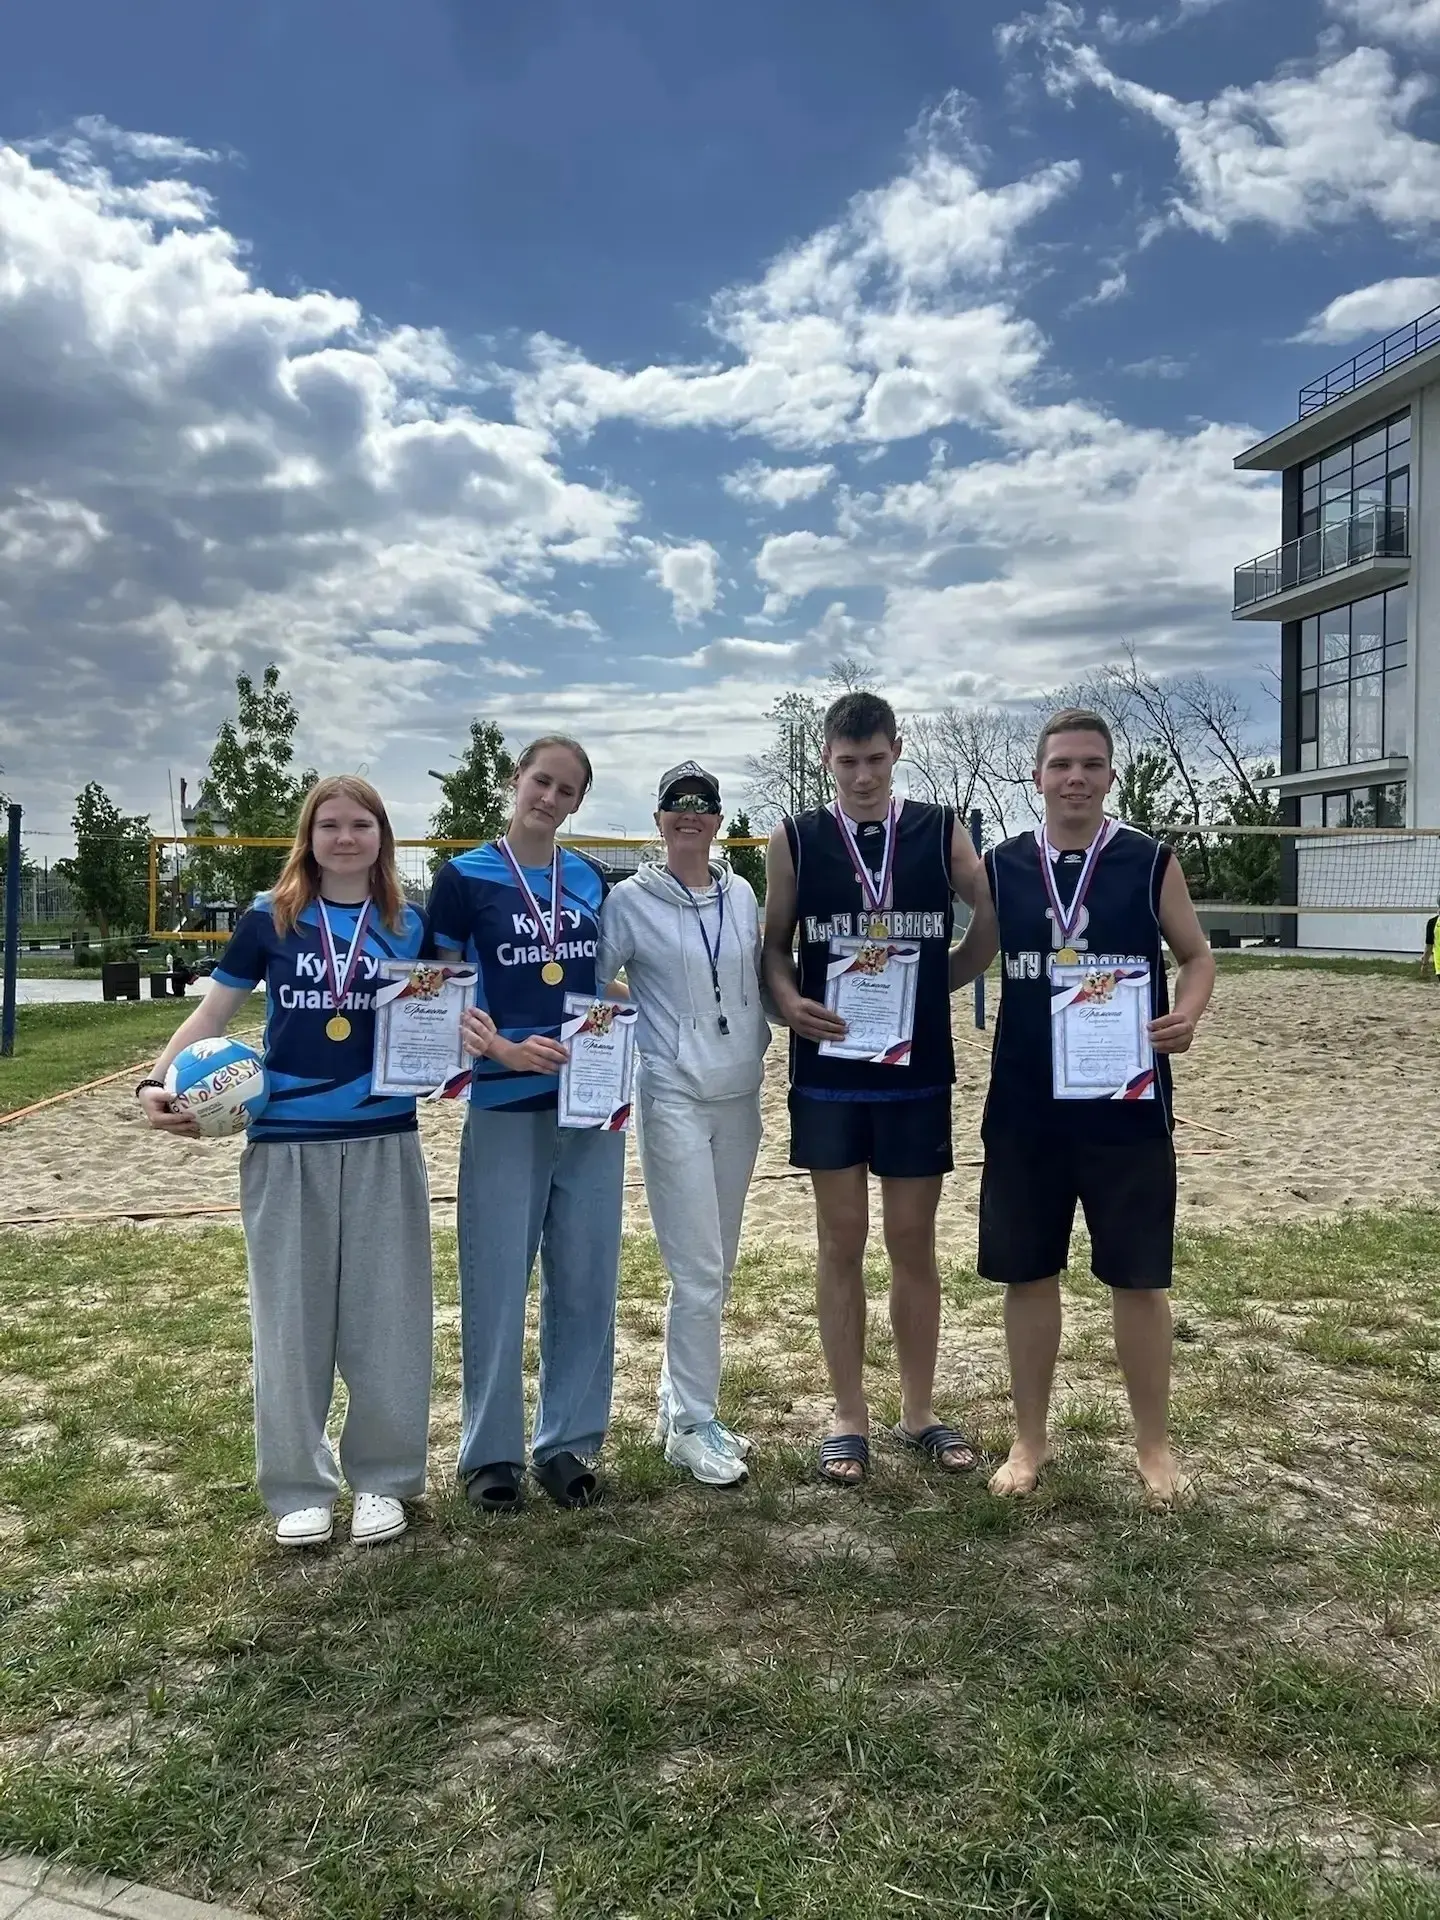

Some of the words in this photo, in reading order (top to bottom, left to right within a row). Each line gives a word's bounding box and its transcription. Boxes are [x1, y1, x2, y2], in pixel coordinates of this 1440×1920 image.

[1045, 904, 1090, 950] 12
[295, 952, 379, 984] КубУ
[279, 984, 378, 1010] Славянс
[404, 1002, 449, 1017] Грамота
[1079, 1007, 1122, 1021] Грамота
